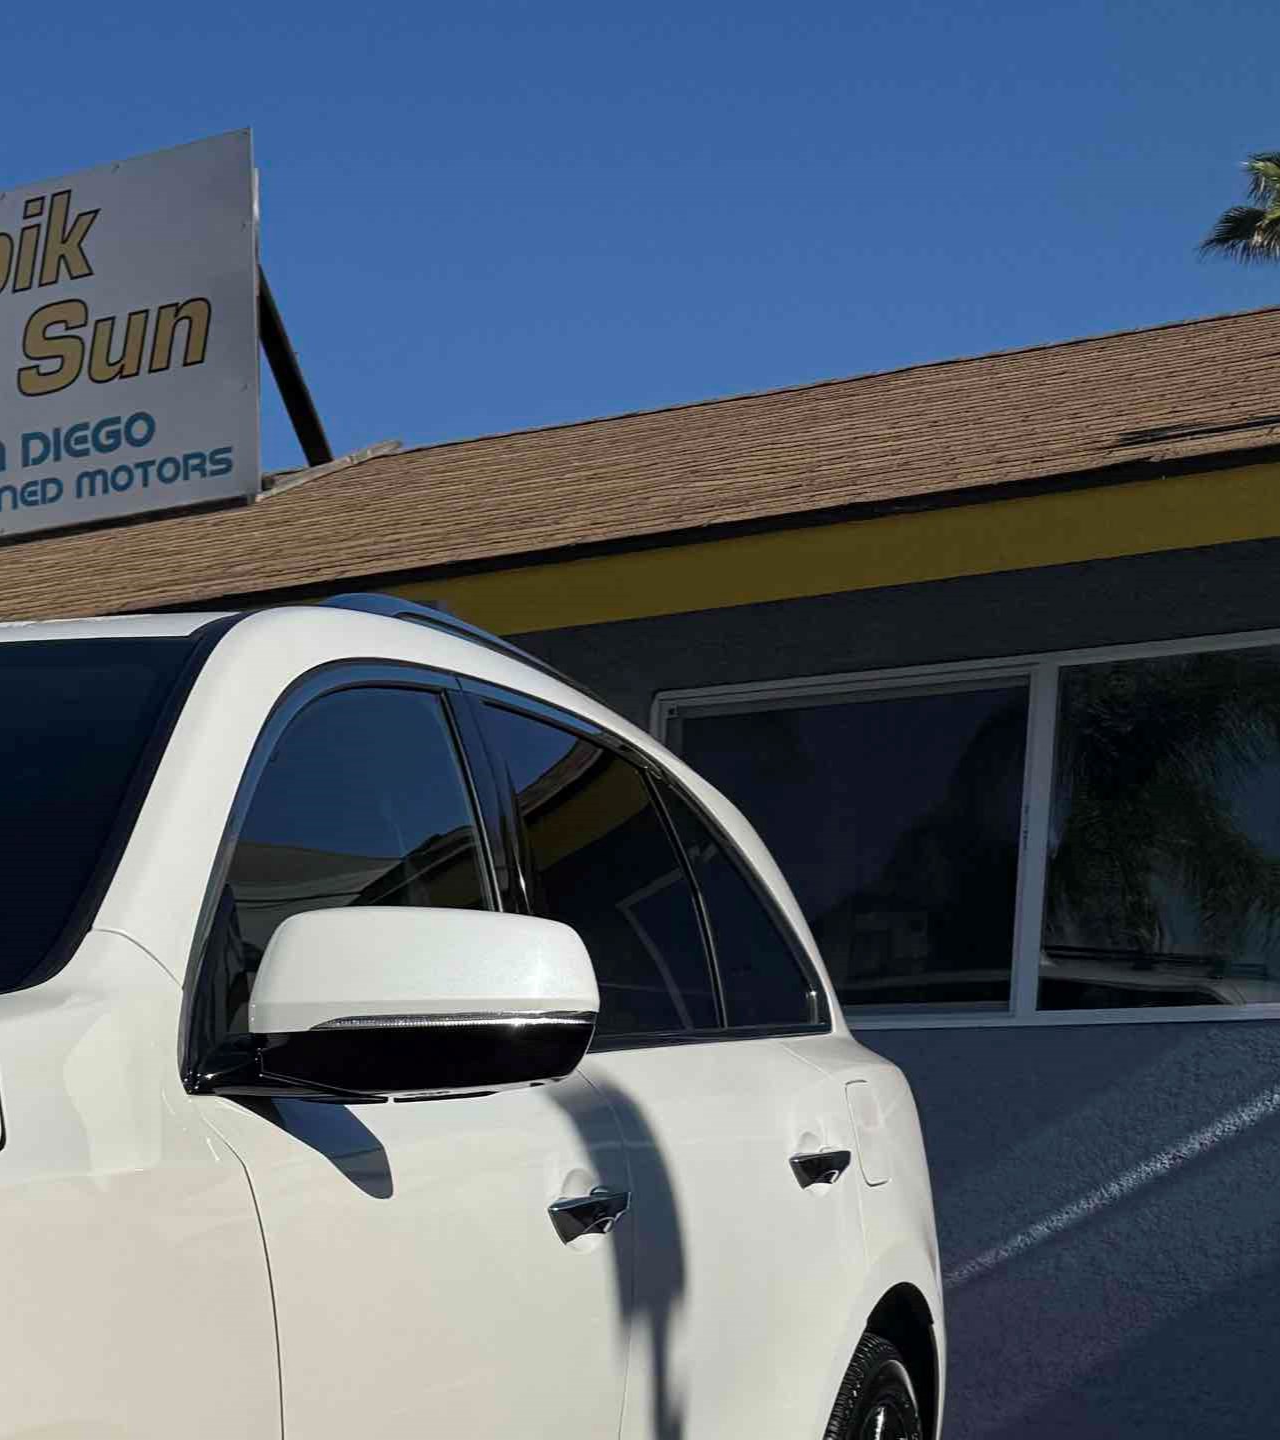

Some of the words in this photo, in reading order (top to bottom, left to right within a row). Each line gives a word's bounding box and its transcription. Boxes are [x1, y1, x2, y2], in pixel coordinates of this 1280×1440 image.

[16, 297, 212, 397] Sun
[21, 411, 155, 468] DIEGO
[75, 446, 234, 499] MOTORS
